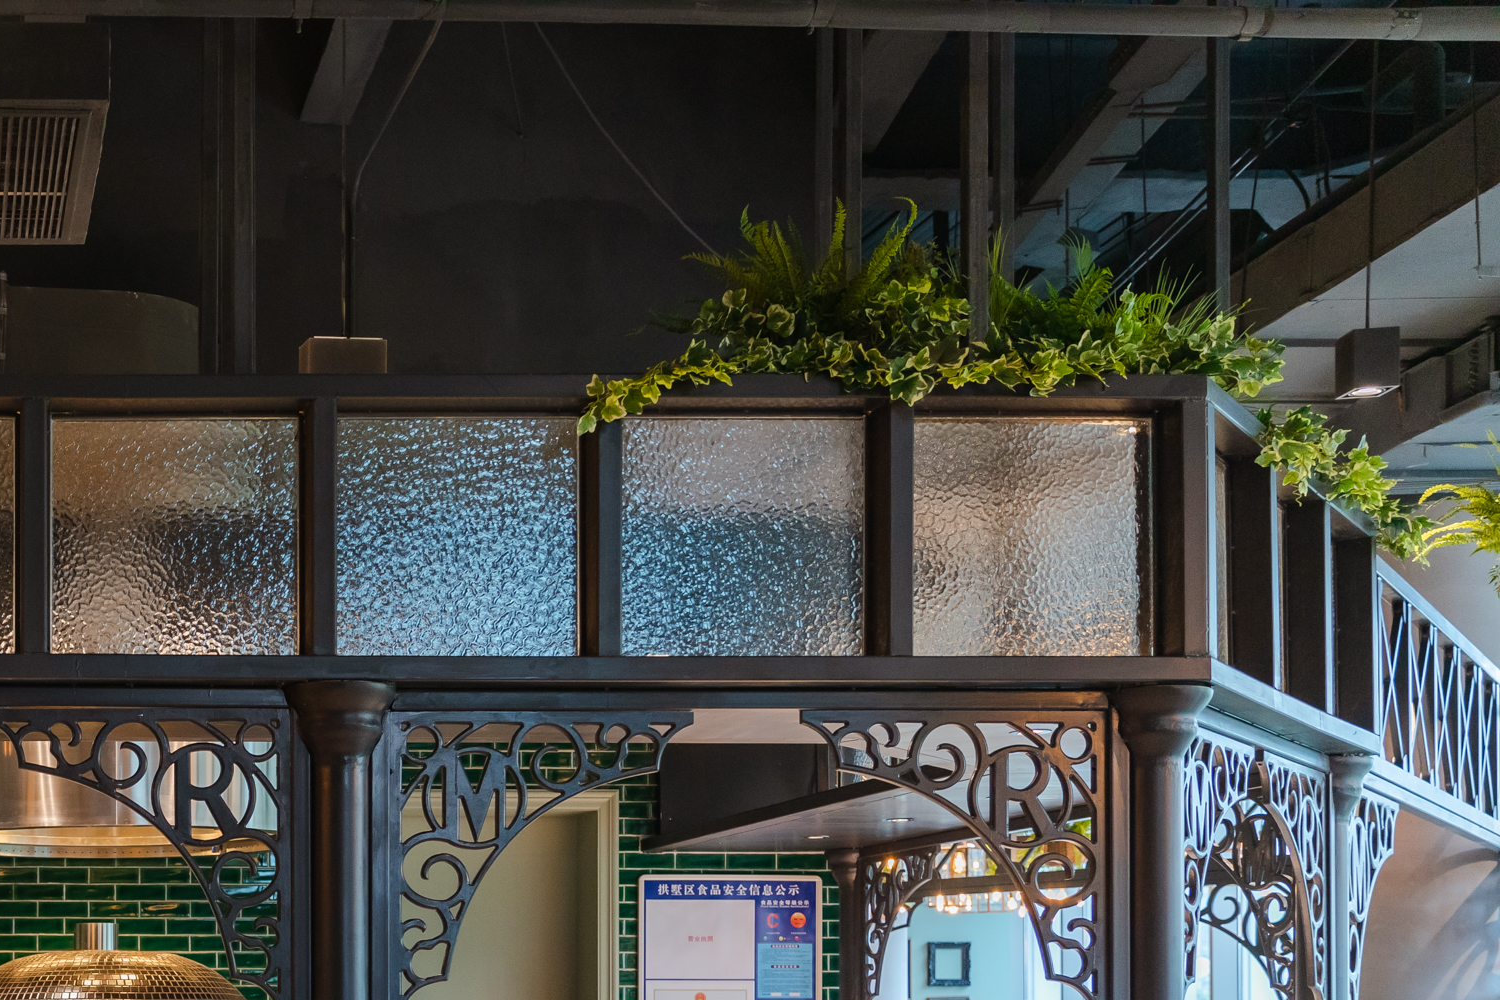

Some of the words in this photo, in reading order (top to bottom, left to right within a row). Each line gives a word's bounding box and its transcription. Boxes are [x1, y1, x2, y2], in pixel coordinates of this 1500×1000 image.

[175, 748, 241, 840] R
[445, 750, 506, 844] M
[995, 751, 1057, 842] R
[657, 884, 800, 896] 拱墅区食品安全信息公示
[766, 913, 779, 928] C
